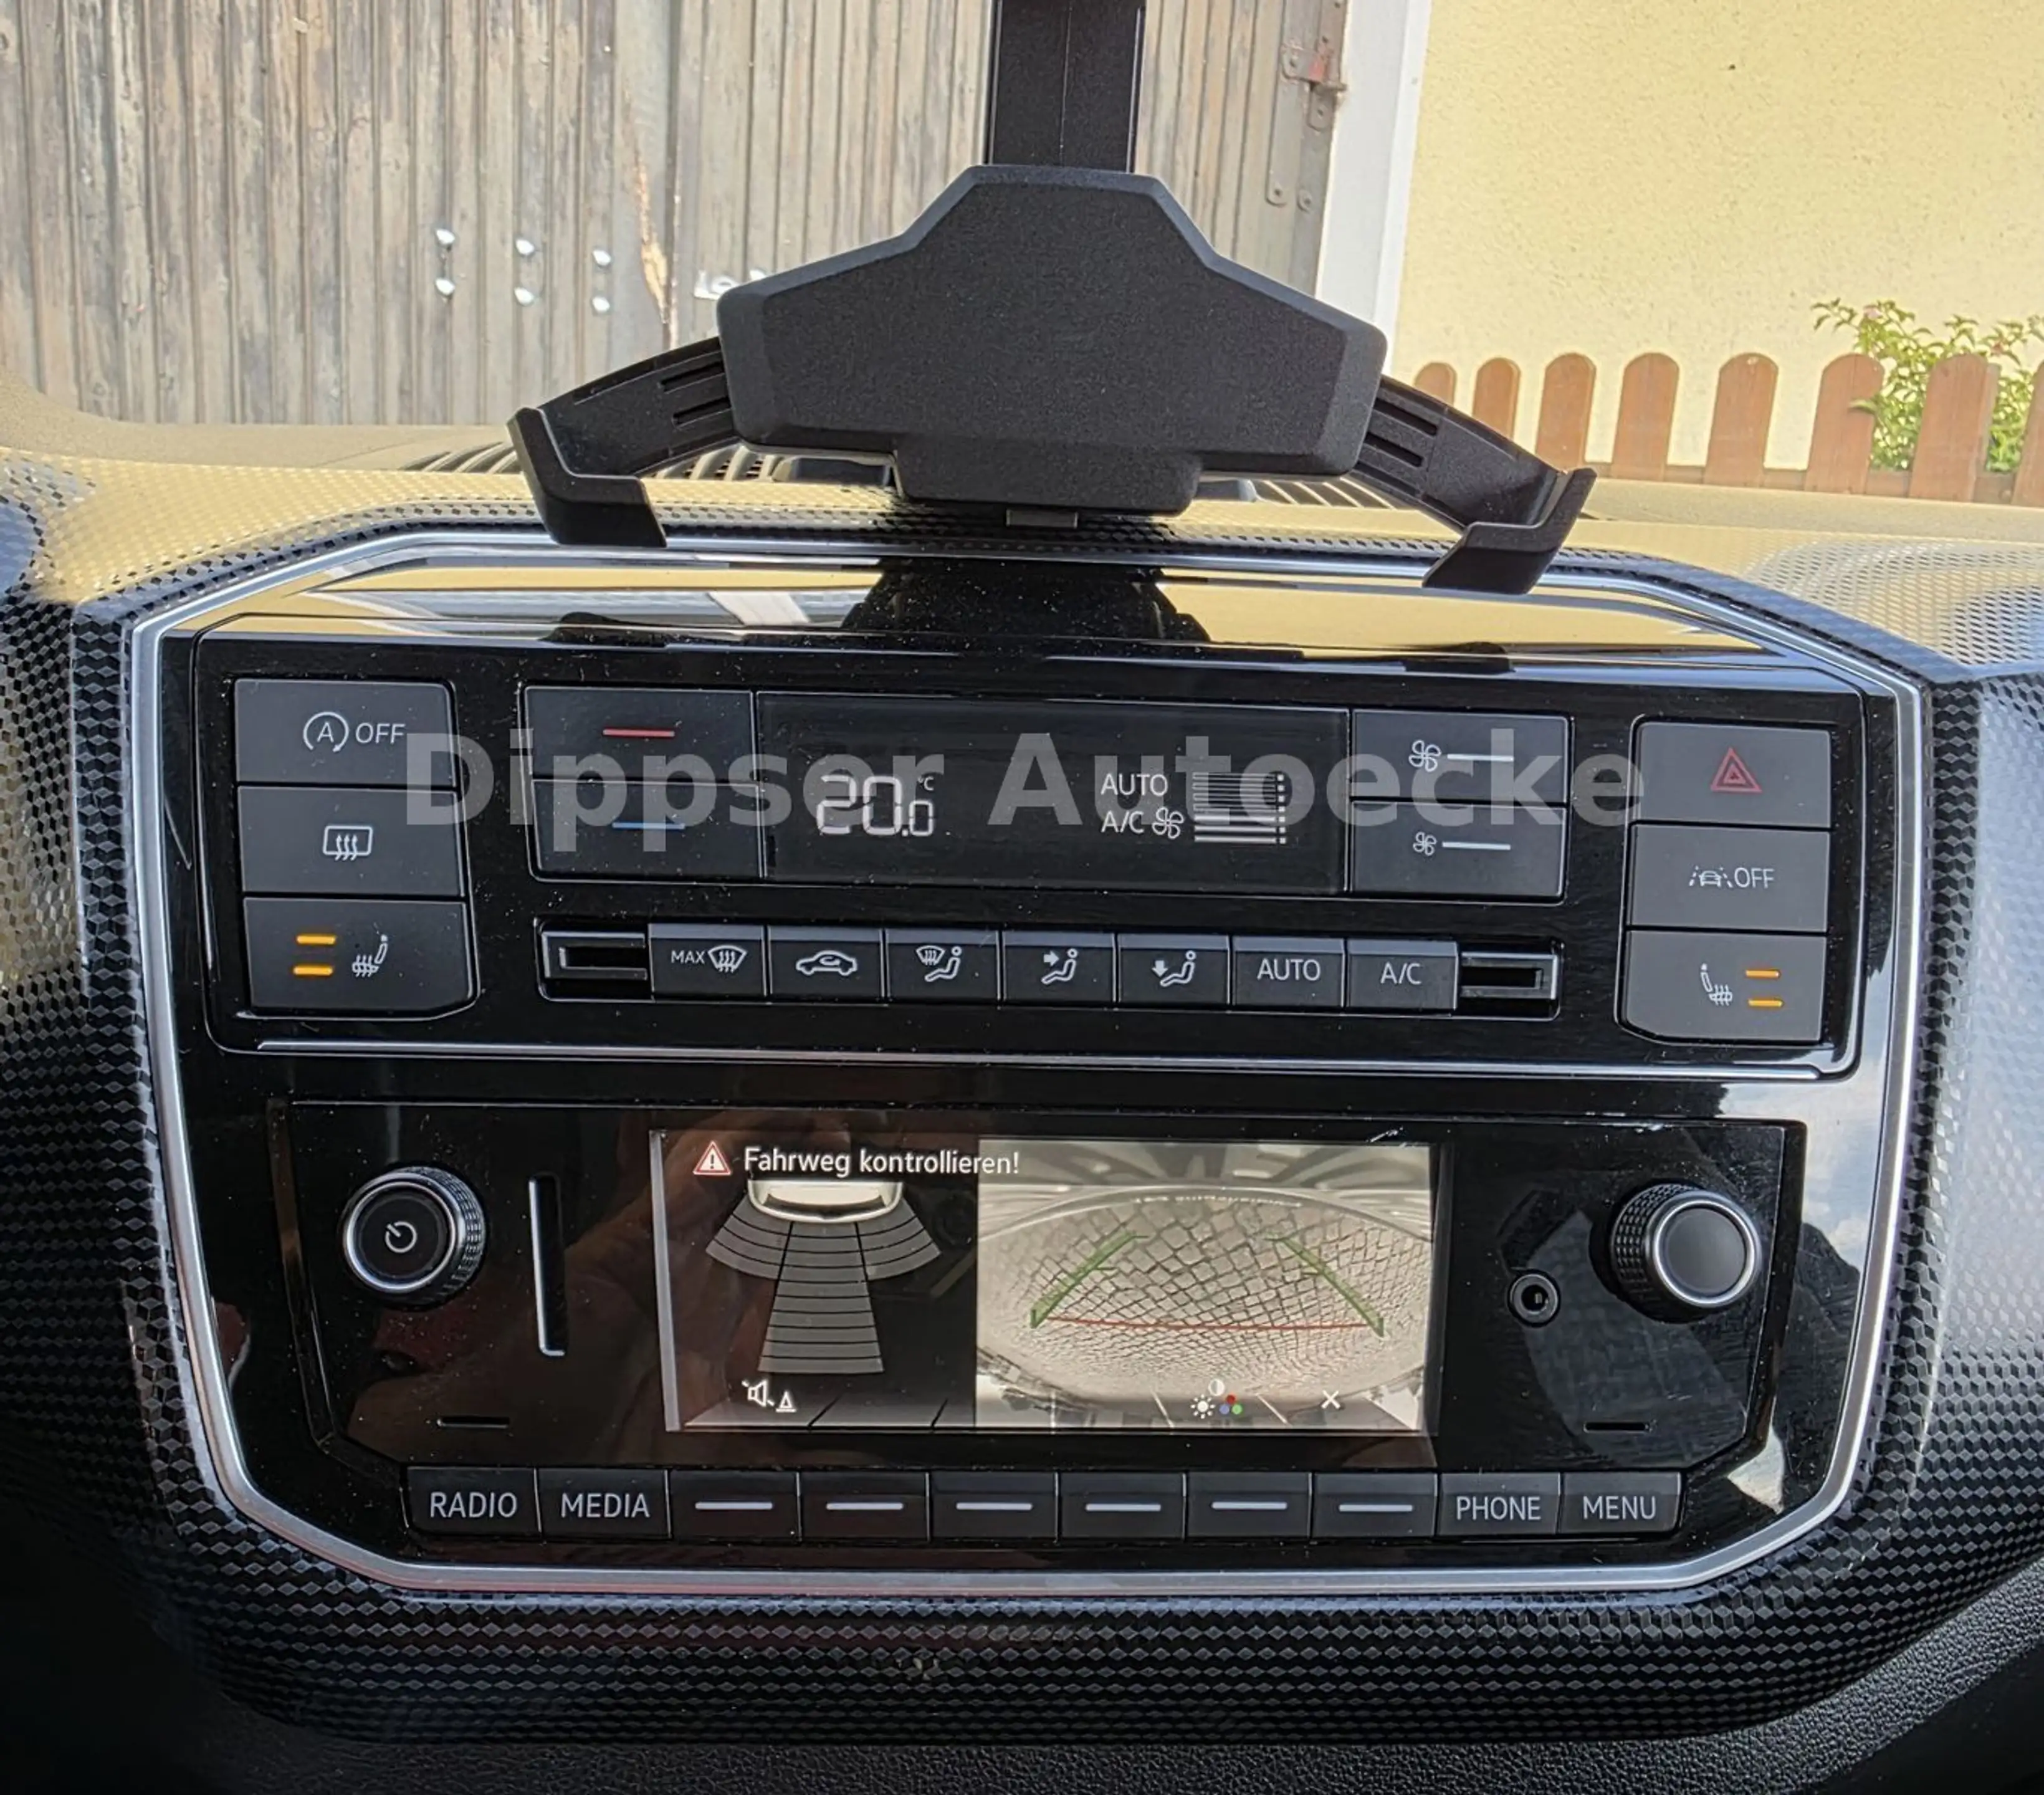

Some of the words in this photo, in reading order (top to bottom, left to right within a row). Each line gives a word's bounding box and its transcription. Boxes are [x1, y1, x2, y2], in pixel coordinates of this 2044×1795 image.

[355, 722, 406, 745] OFF
[1101, 773, 1168, 797] AUTO
[1101, 811, 1145, 835] A/C
[1734, 868, 1775, 889] OFF
[671, 949, 705, 966] MAX
[1257, 958, 1320, 982] AUTO
[1380, 962, 1423, 987] A/C
[743, 1146, 851, 1177] Fahrweg
[859, 1149, 1020, 1175] kontrollieren!
[429, 1491, 518, 1518] RADIO
[561, 1492, 650, 1518] MEDIA
[1456, 1496, 1541, 1521] PHONE
[1583, 1495, 1656, 1520] MENU
